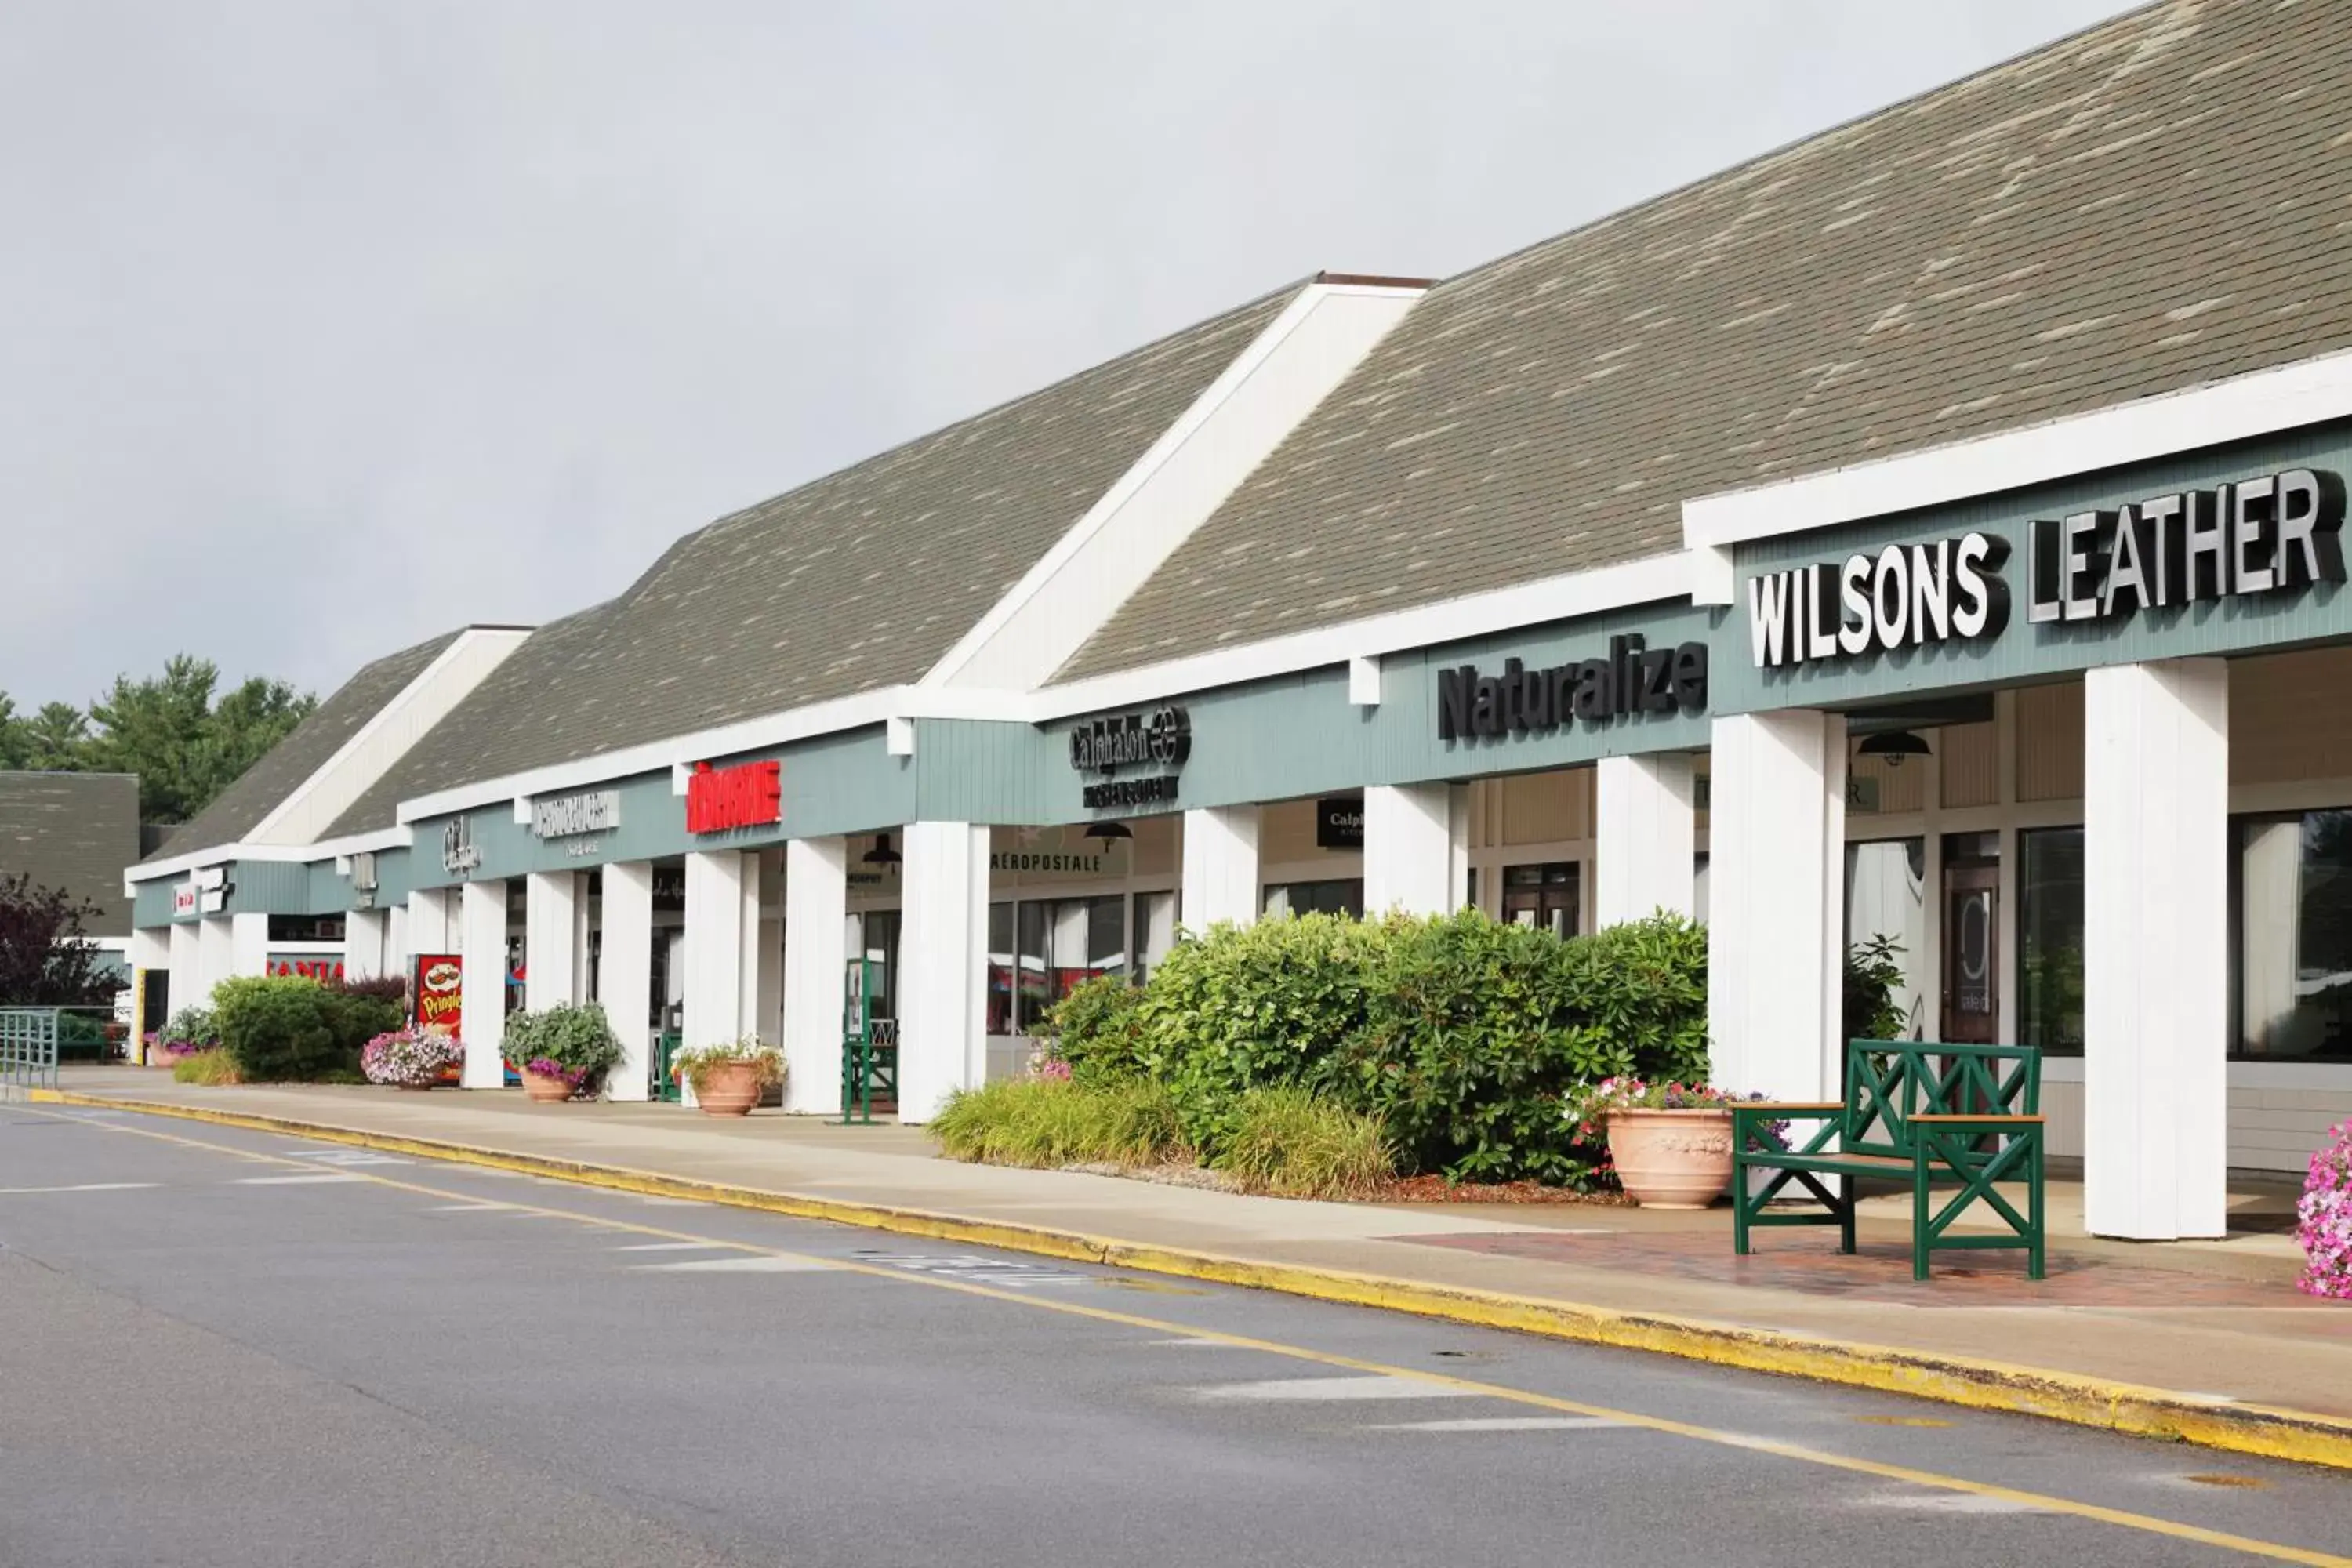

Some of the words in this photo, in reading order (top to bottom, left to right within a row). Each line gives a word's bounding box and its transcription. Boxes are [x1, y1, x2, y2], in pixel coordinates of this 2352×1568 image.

[1748, 530, 2012, 668] WILSONS
[2027, 468, 2350, 624] LEATHER
[1438, 632, 1708, 740] Naturalize
[1069, 713, 1152, 775] Calphalon
